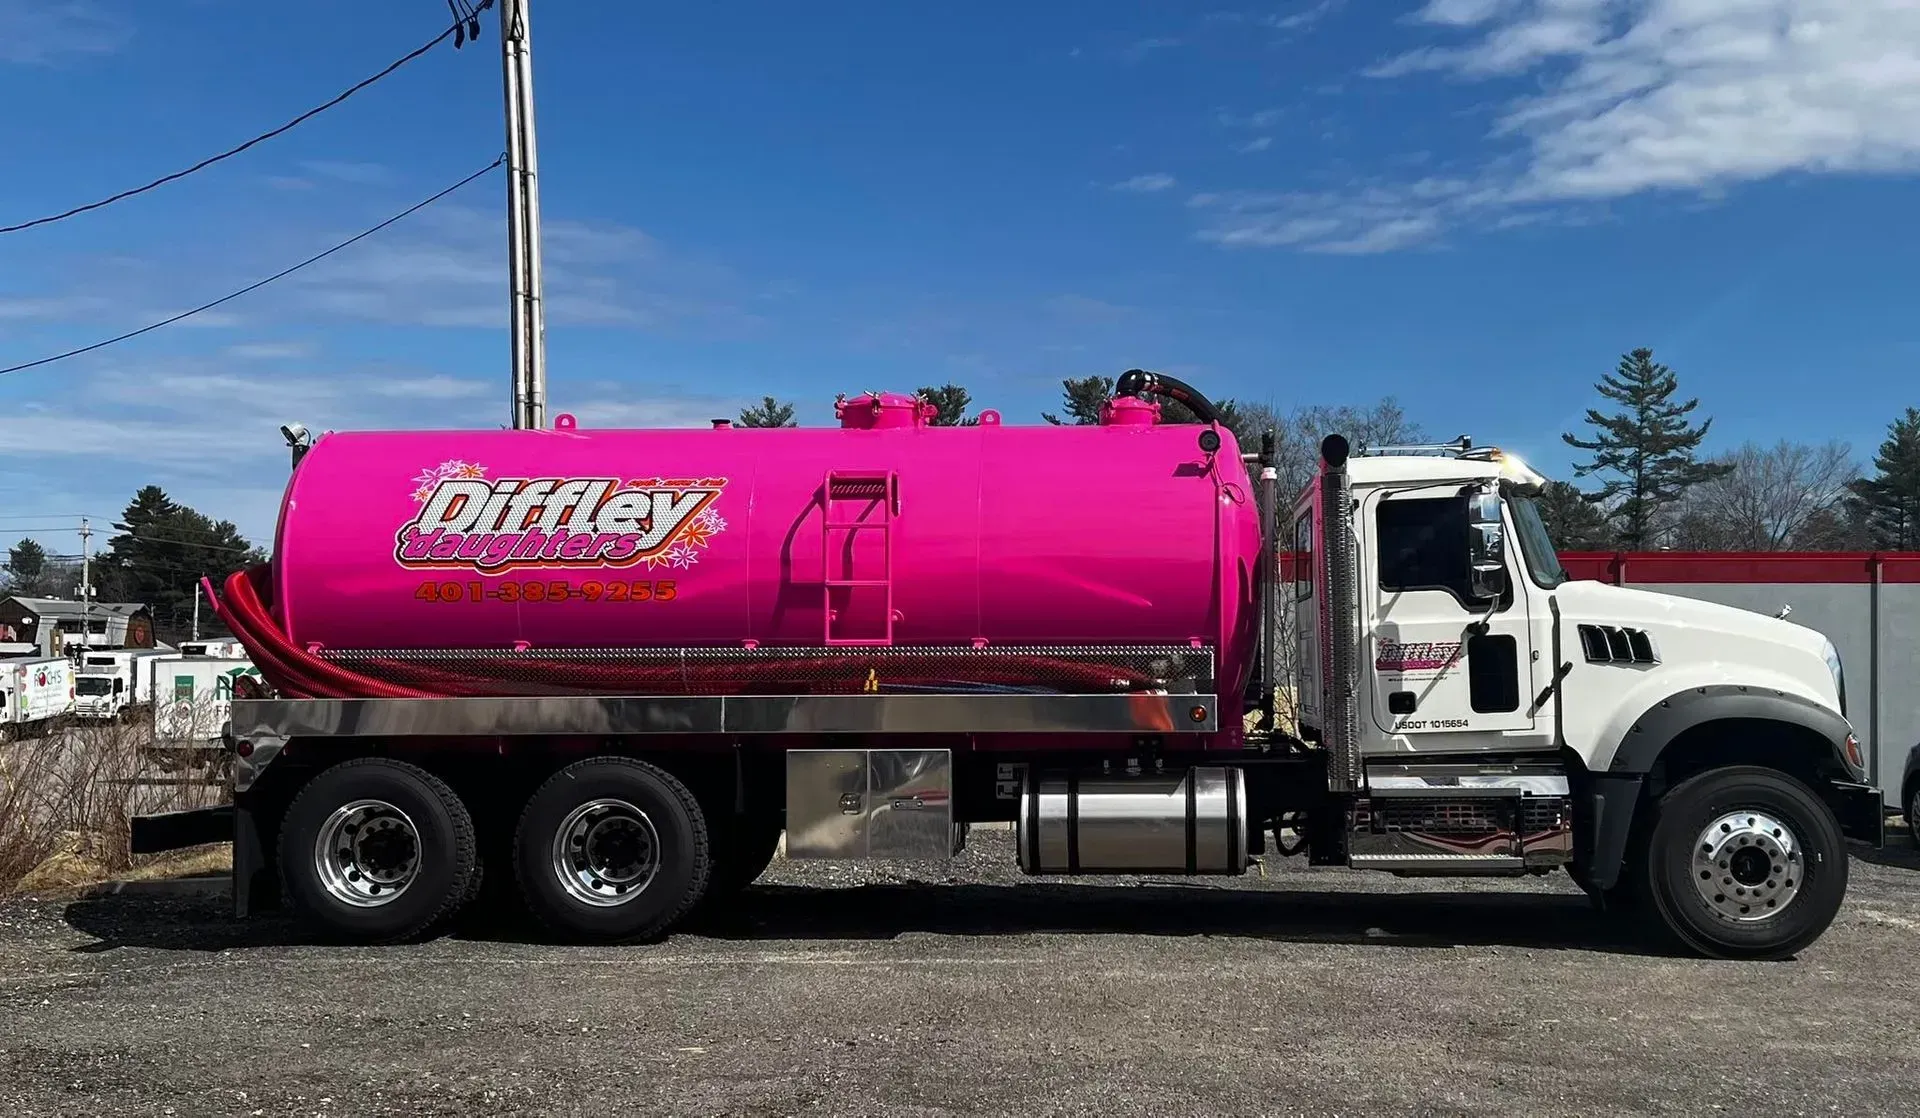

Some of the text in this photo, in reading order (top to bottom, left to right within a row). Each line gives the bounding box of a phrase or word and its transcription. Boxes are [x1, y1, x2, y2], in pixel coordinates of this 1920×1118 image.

[418, 480, 717, 551] Diffley
[414, 580, 678, 603] 401-385-9255
[1395, 719, 1469, 730] USDOT 1015654
